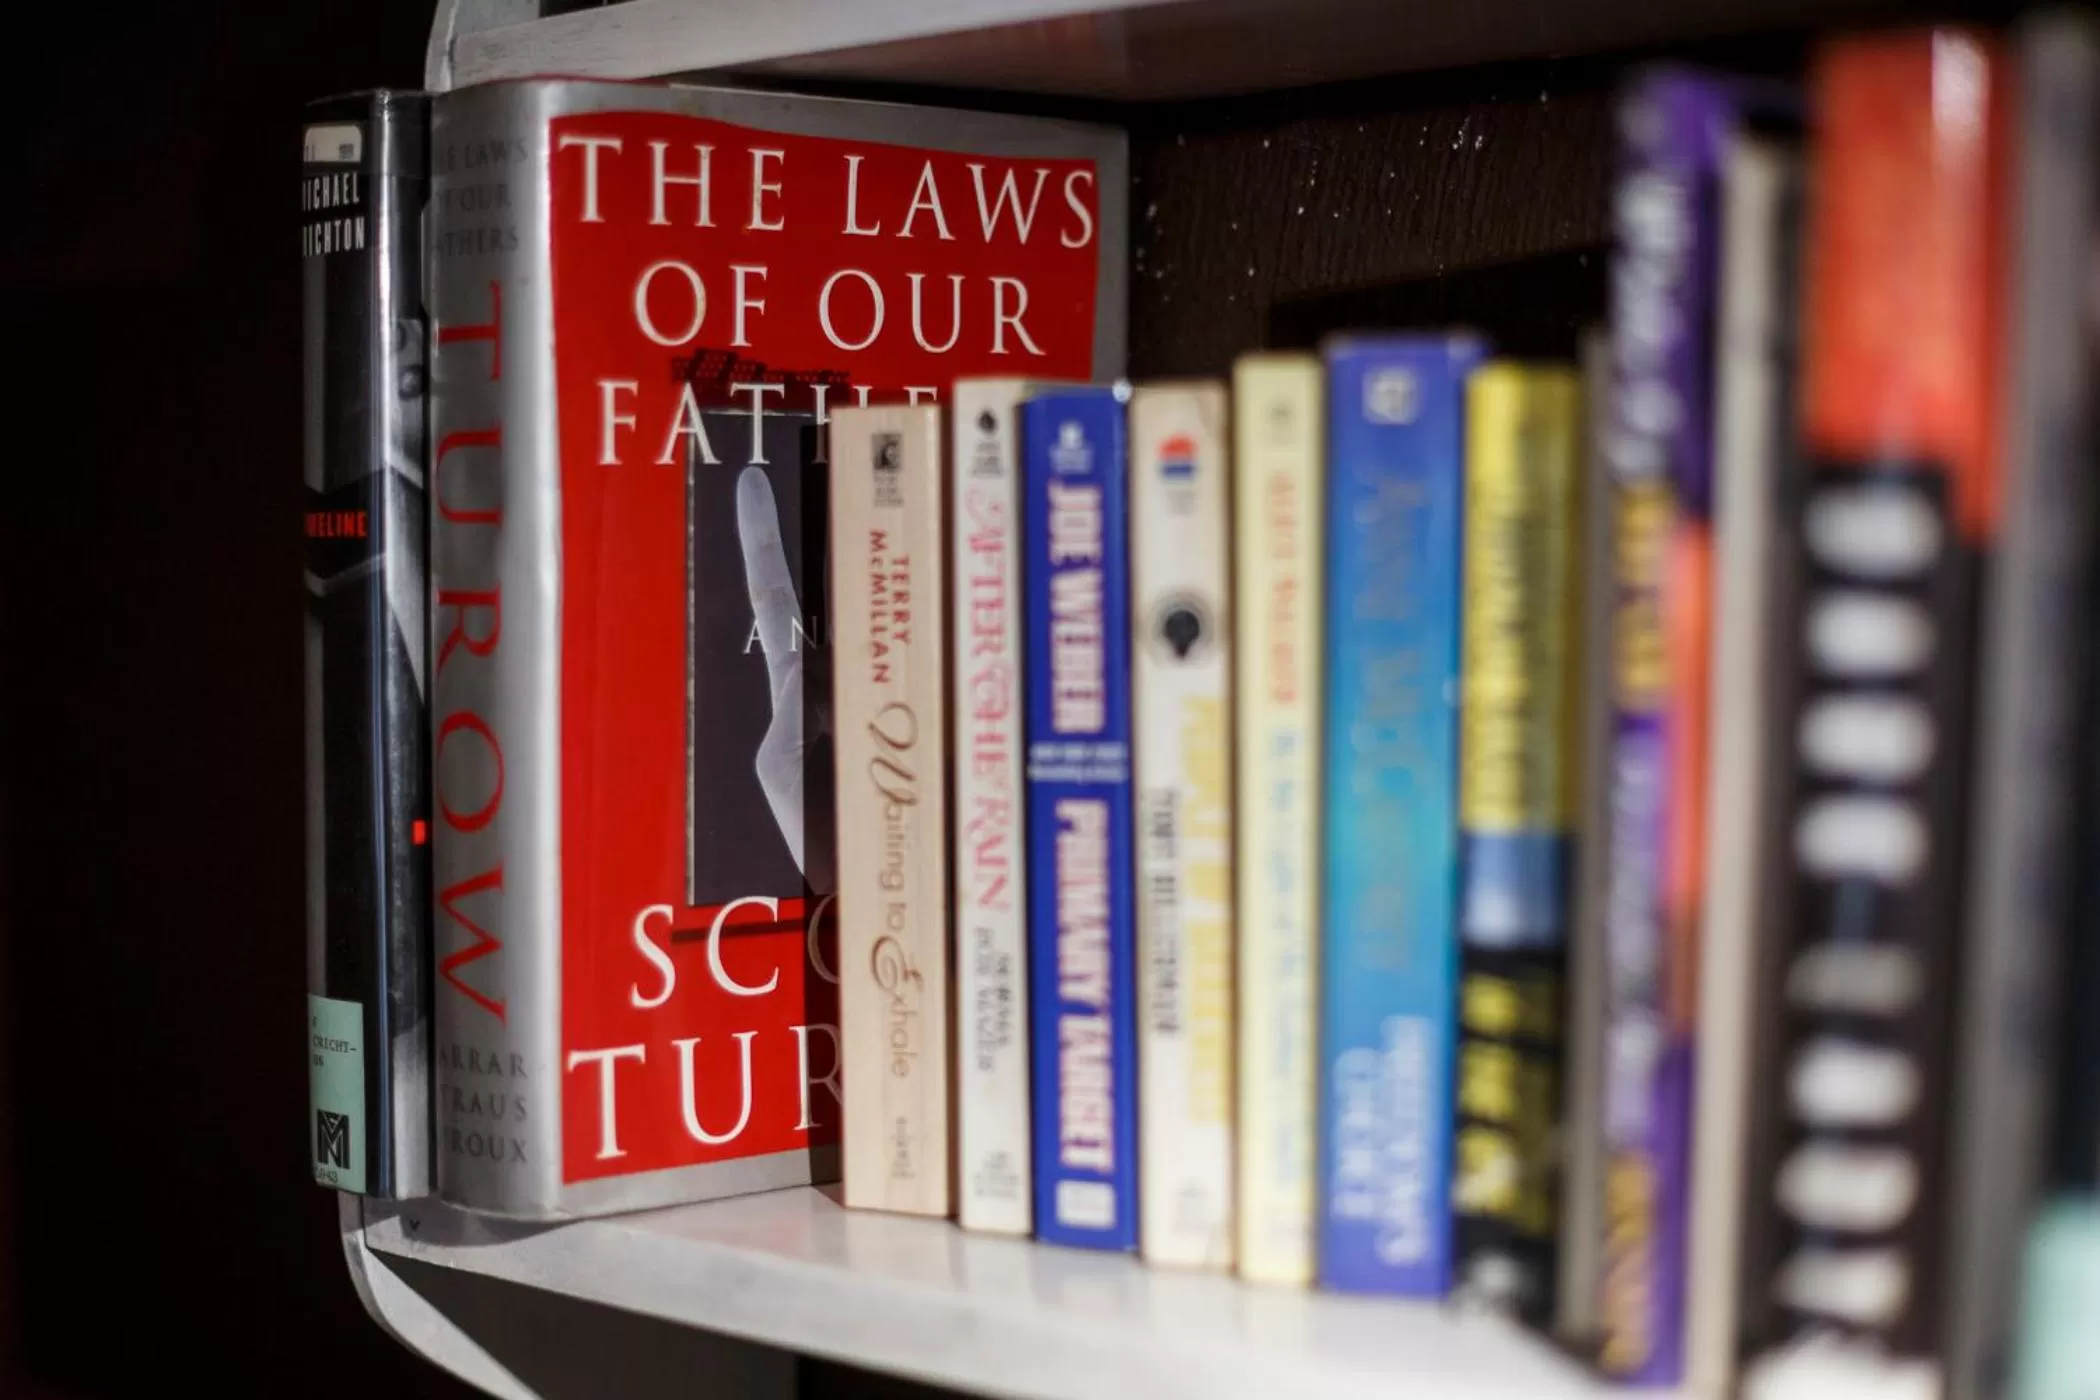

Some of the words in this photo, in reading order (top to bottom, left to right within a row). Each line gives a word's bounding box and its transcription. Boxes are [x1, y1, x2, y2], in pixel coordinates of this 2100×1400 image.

[558, 134, 786, 232] THE
[842, 154, 1094, 249] LAWS
[634, 260, 768, 347] OF
[818, 269, 1046, 356] OUR
[963, 488, 1012, 656] AFTER
[1048, 480, 1103, 564] JOE
[436, 279, 507, 1024] TUROW
[868, 529, 892, 684] McMILLAN
[891, 554, 911, 645] TERRY
[1050, 567, 1106, 734] WEBER
[868, 702, 920, 889] Waiting
[963, 797, 1012, 911] RAIN
[887, 900, 908, 932] to
[1054, 797, 1110, 1011] PRIMARY
[440, 1043, 528, 1078] ARRAR
[870, 935, 924, 1079] Exhale
[440, 1083, 528, 1121] TRAUS
[444, 1125, 528, 1163] ROUX
[567, 1023, 843, 1160] TUR
[1057, 1013, 1113, 1175] TARGET
